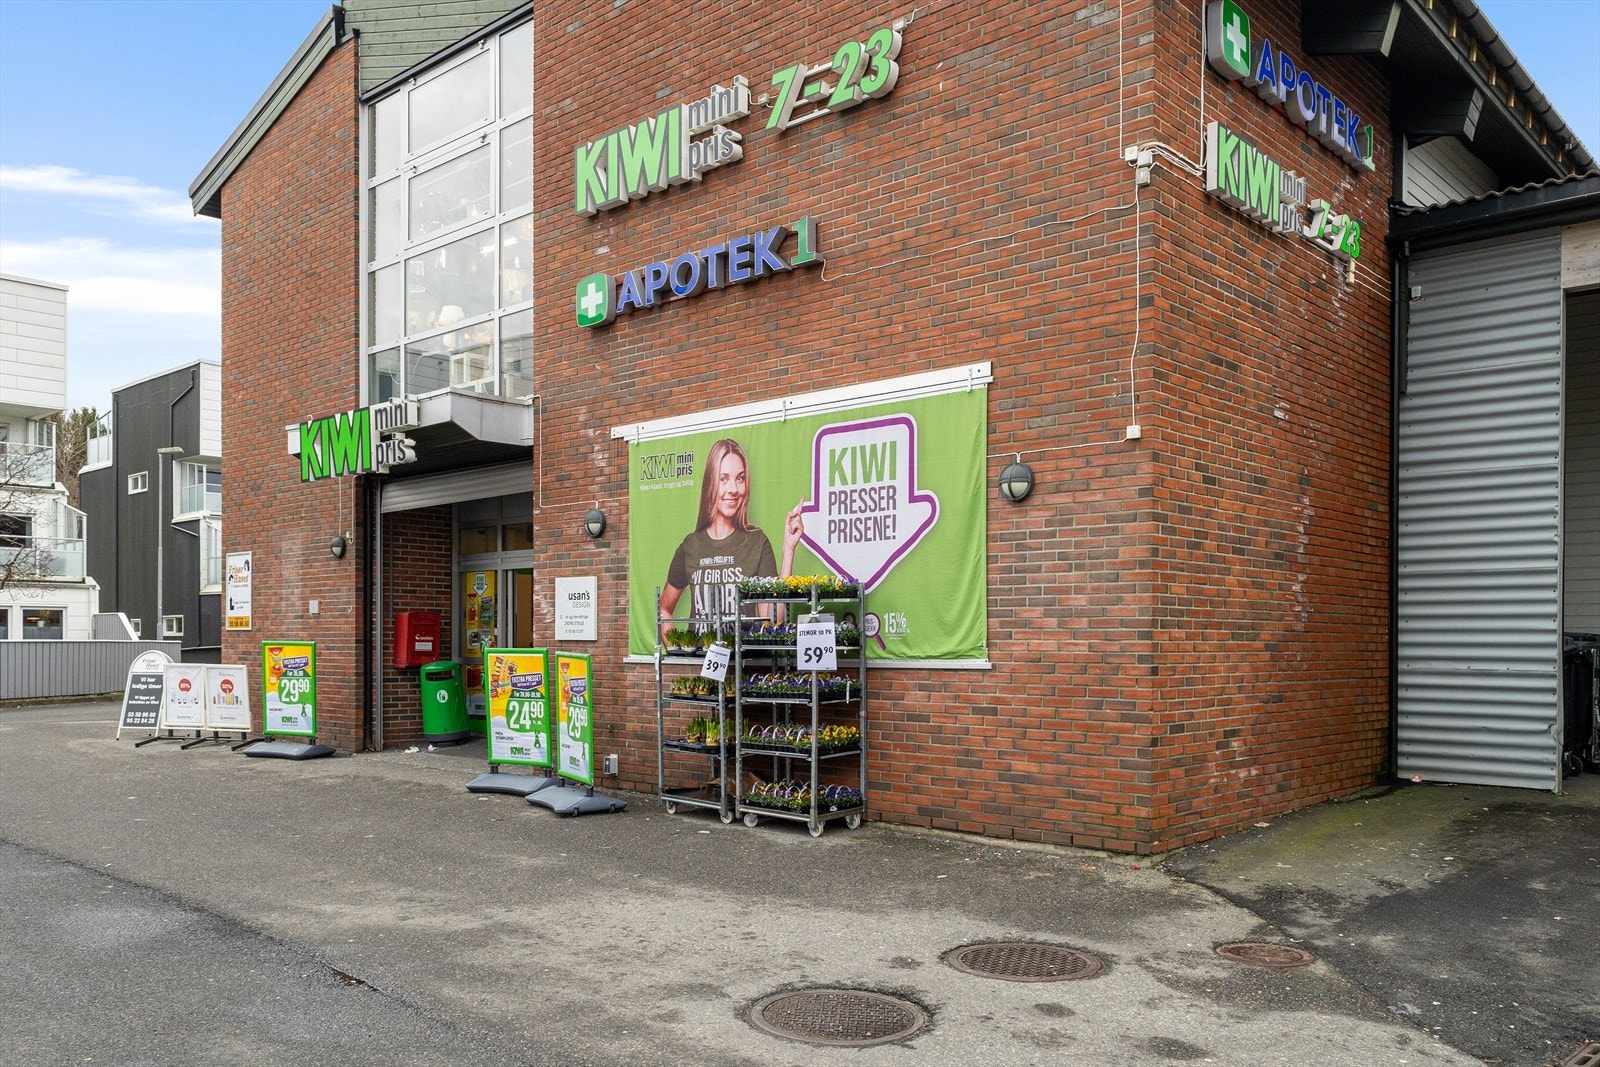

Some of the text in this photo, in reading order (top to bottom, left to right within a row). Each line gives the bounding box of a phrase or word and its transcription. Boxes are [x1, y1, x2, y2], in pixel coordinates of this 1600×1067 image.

[765, 27, 899, 131] 7-23
[1256, 38, 1375, 171] APOTEK 1
[575, 75, 747, 217] KIWI mini
[688, 127, 742, 180] pris
[1215, 121, 1306, 227] KIWI mini
[1281, 203, 1304, 236] pris
[616, 215, 818, 313] APOTEK 1
[300, 394, 417, 483] KIWI mini
[375, 433, 412, 473] pris
[640, 450, 694, 480] KIWI mini
[676, 463, 693, 479] pris
[828, 440, 897, 487] KIWI
[828, 485, 897, 516] PRESSER
[827, 514, 897, 544] PRISENE!
[568, 590, 591, 600] usan's
[704, 569, 720, 583] GIR
[722, 567, 742, 582] OSS
[884, 612, 907, 633] 15%
